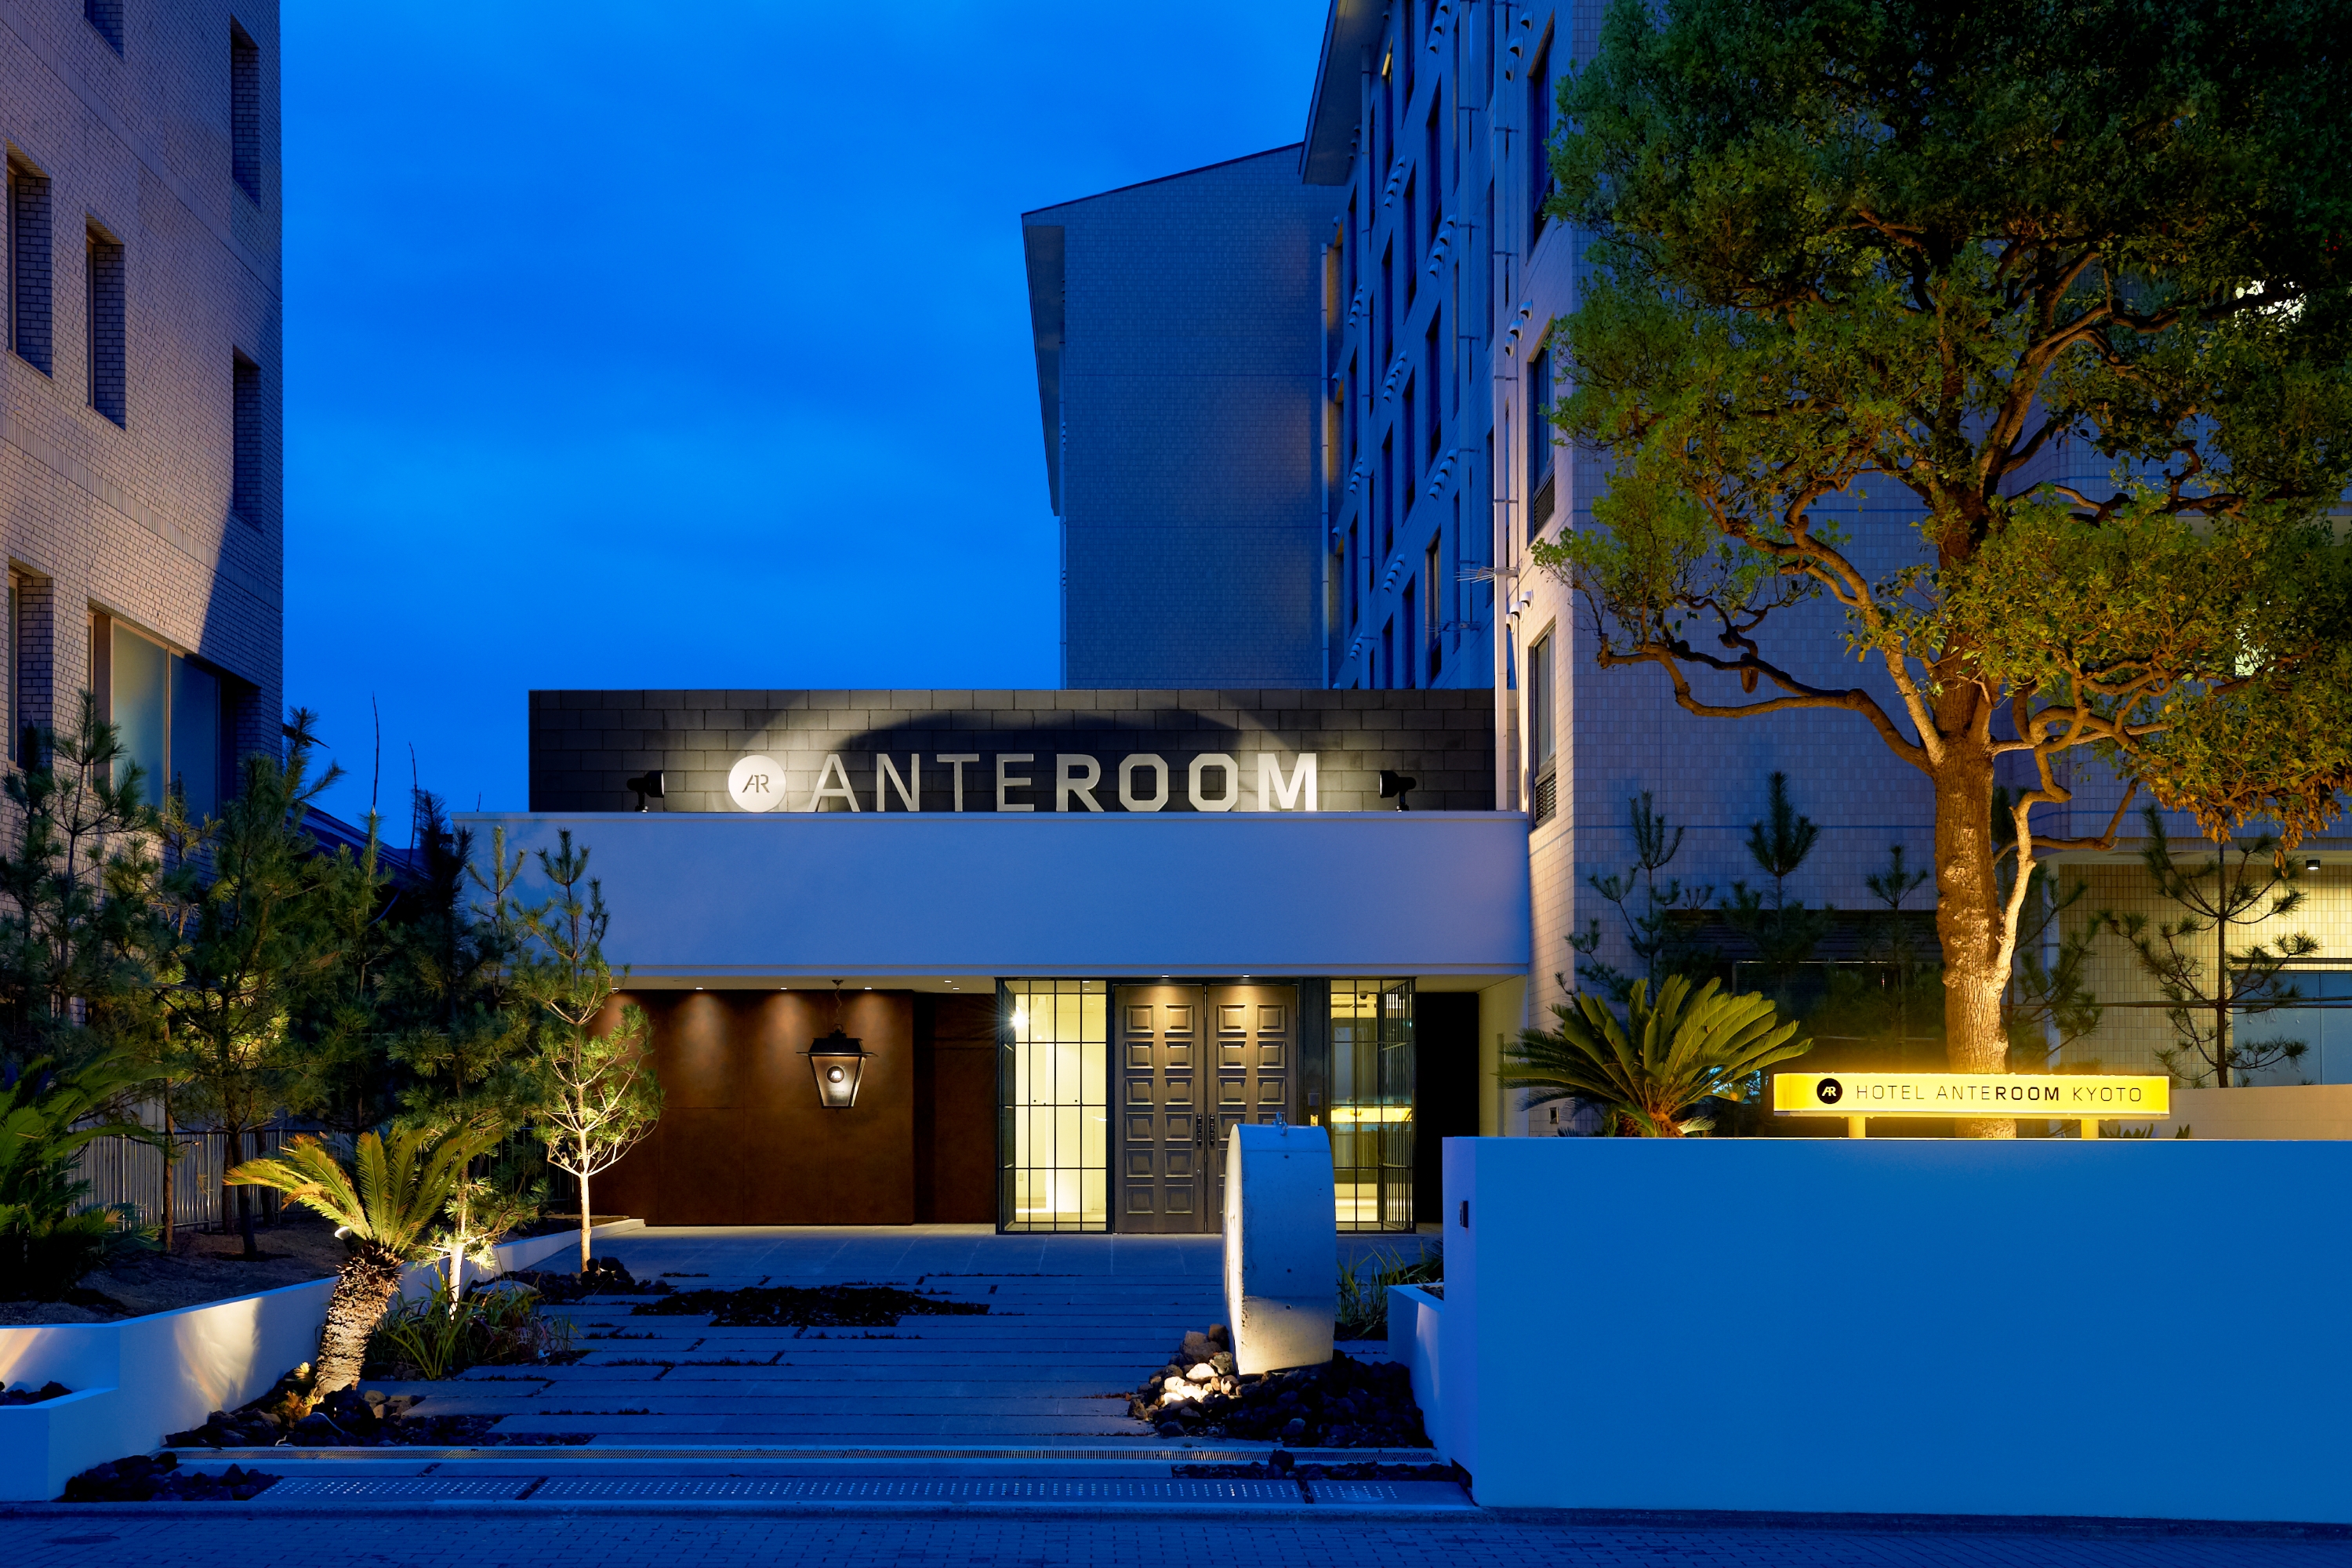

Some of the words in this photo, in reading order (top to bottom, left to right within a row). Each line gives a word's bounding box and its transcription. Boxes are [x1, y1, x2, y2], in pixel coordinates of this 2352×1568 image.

[807, 753, 1318, 812] ANTEROOM
[1821, 1086, 1837, 1097] AR
[1857, 1085, 1925, 1100] HOTEL
[1936, 1086, 2060, 1102] ANTEROOM
[2073, 1087, 2142, 1102] KYOTO
